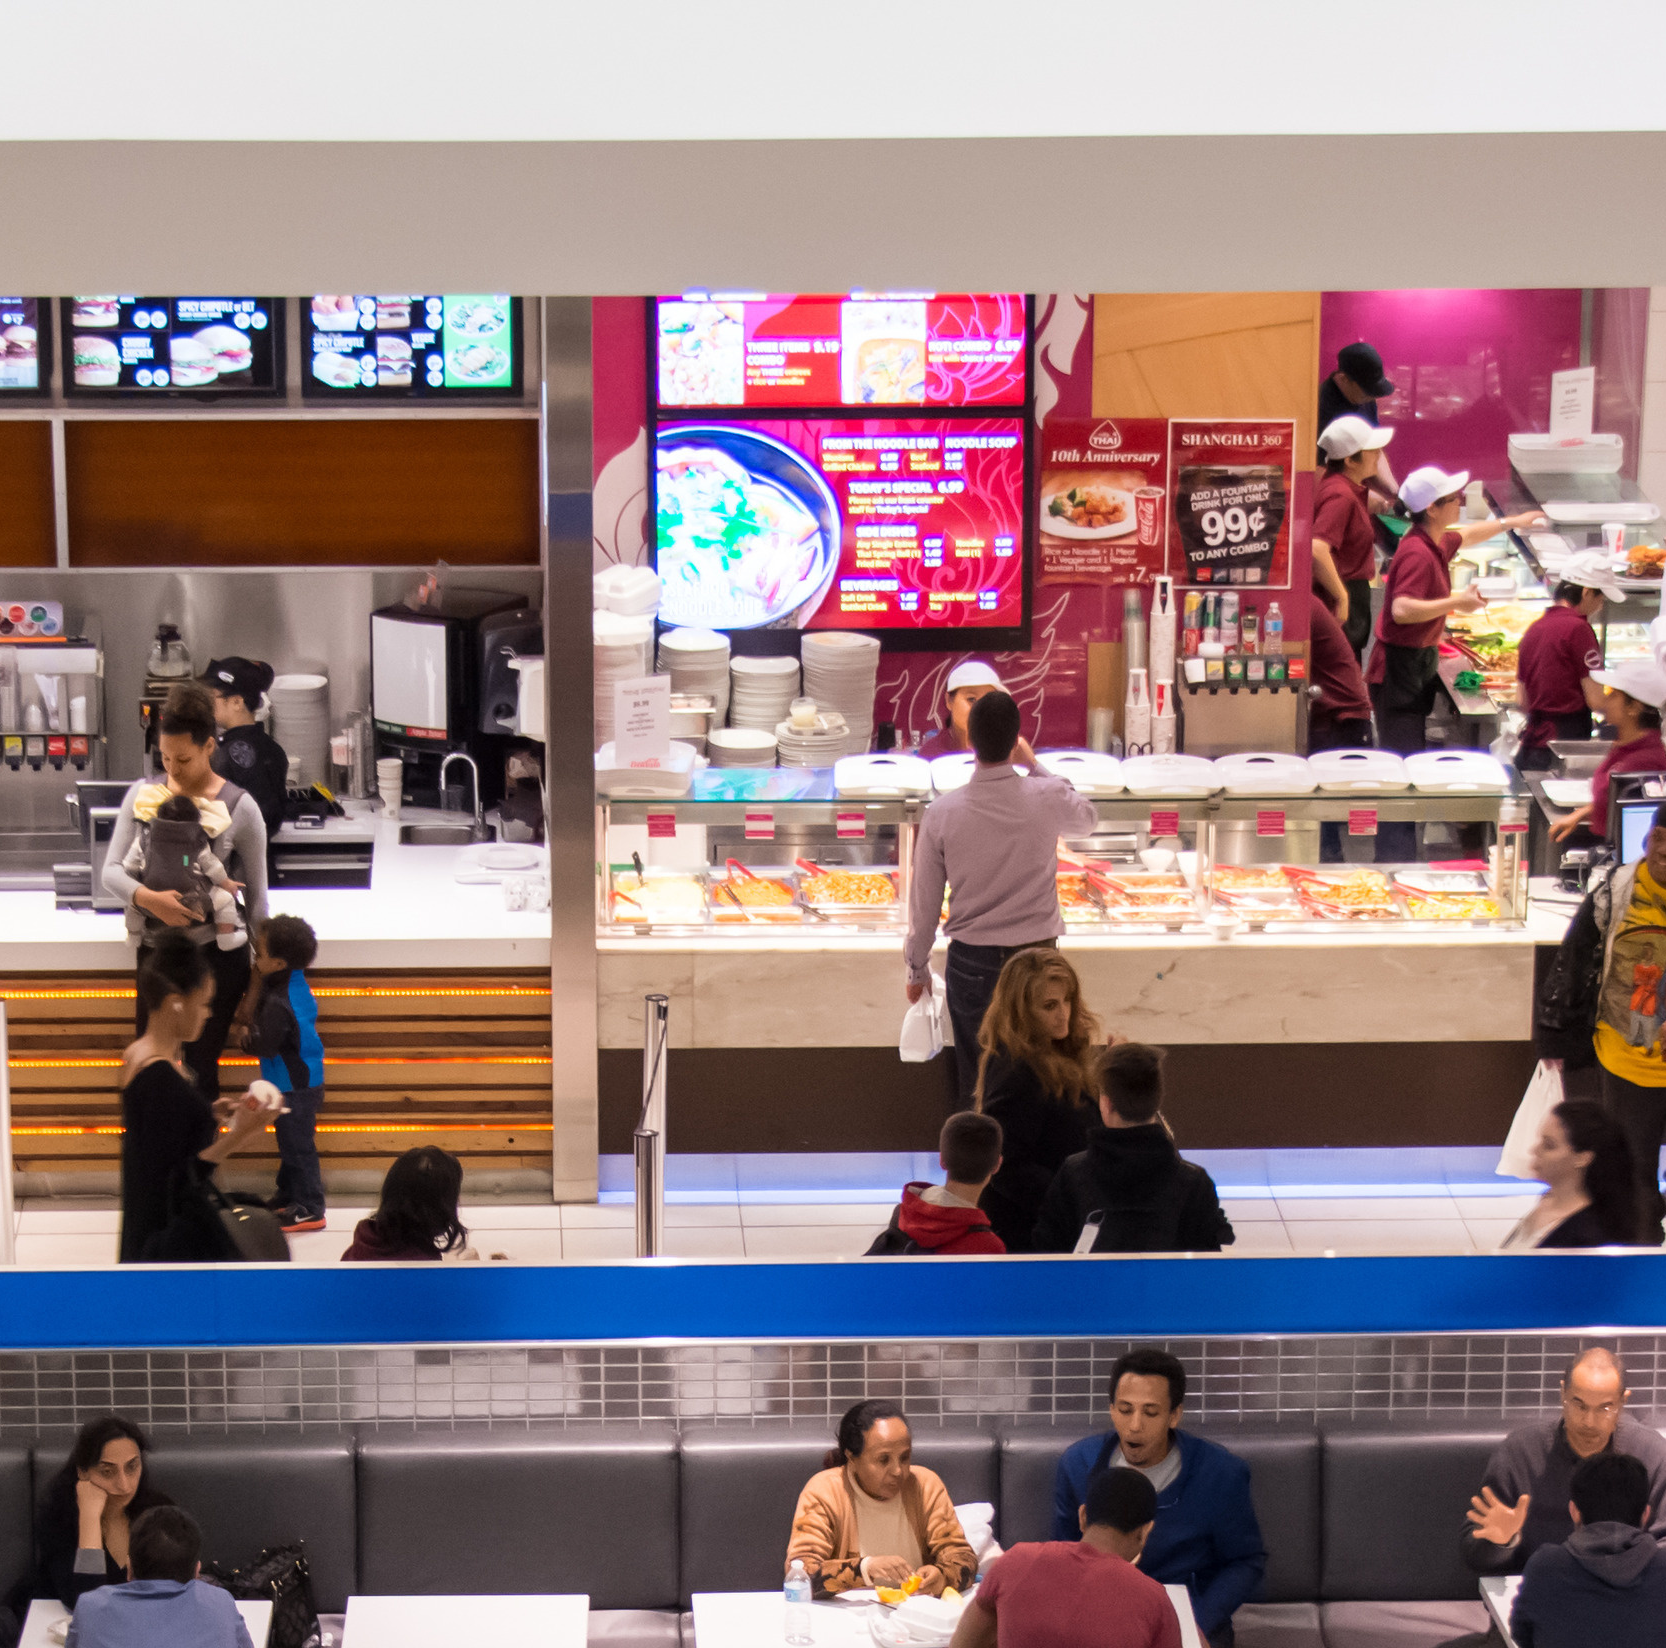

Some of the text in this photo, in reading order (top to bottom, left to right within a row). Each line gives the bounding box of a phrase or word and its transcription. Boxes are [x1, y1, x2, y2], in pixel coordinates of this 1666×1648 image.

[178, 301, 199, 312] SPICY
[746, 341, 778, 352] THREE
[780, 341, 810, 352] ITEMS
[953, 341, 991, 352] COMBO
[746, 355, 785, 365] COMBO
[961, 354, 983, 362] choice
[985, 354, 993, 362] of
[994, 355, 1012, 363] curry
[822, 438, 939, 449] FROM THE NOODLE BAR
[945, 437, 1018, 449] NOODLE SOUP
[1093, 437, 1118, 445] THAI
[1182, 434, 1281, 446] SHANGHAI 360
[1051, 449, 1161, 467] 10th Anniversary
[847, 463, 875, 471] Chicken
[848, 481, 965, 493] TODAY'S SPECIAL 6.99
[1190, 483, 1269, 501] ADD A FOUNTAIN
[1191, 492, 1270, 511] DRINK FOR ONLY
[876, 505, 902, 515] Today's
[903, 505, 929, 514] Special
[856, 526, 917, 537] SIDE DISHES
[1201, 506, 1266, 547] 99¢
[856, 541, 870, 549] Any
[871, 541, 893, 549] Single
[856, 550, 871, 558] Thai
[872, 550, 895, 559] Spring
[1189, 542, 1269, 562] TO ANY COMBO
[856, 560, 871, 568] Fried
[1110, 557, 1137, 565] Regular
[840, 580, 899, 591] BEVERAGES
[840, 594, 876, 602] Soft Drink
[929, 593, 976, 601] Bottled Water
[669, 600, 762, 617] NOODLE SOUP
[840, 603, 887, 611] Bottled Drink
